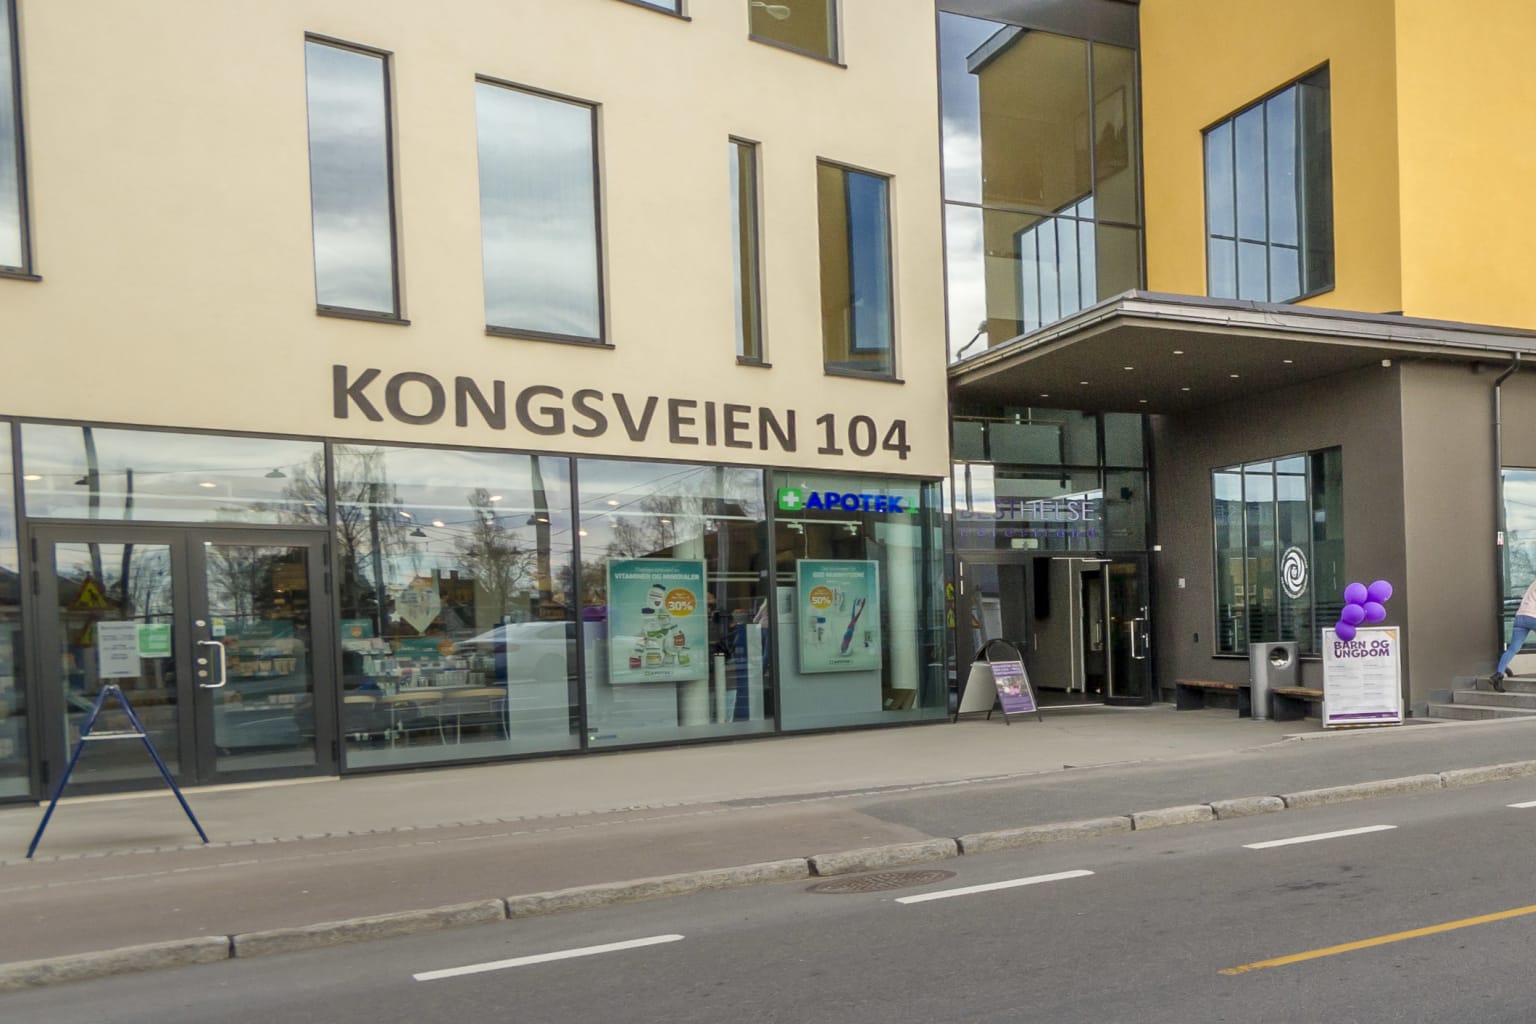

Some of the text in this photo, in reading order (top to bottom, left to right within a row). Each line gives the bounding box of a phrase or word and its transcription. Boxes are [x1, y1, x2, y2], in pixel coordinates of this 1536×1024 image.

[332, 364, 911, 461] KONGSVEIEN 104
[805, 491, 904, 514] APOTEK
[812, 596, 832, 605] 50%
[668, 601, 693, 611] 30%
[1334, 640, 1390, 650] BARN OG
[1334, 648, 1390, 658] UNGDOM
